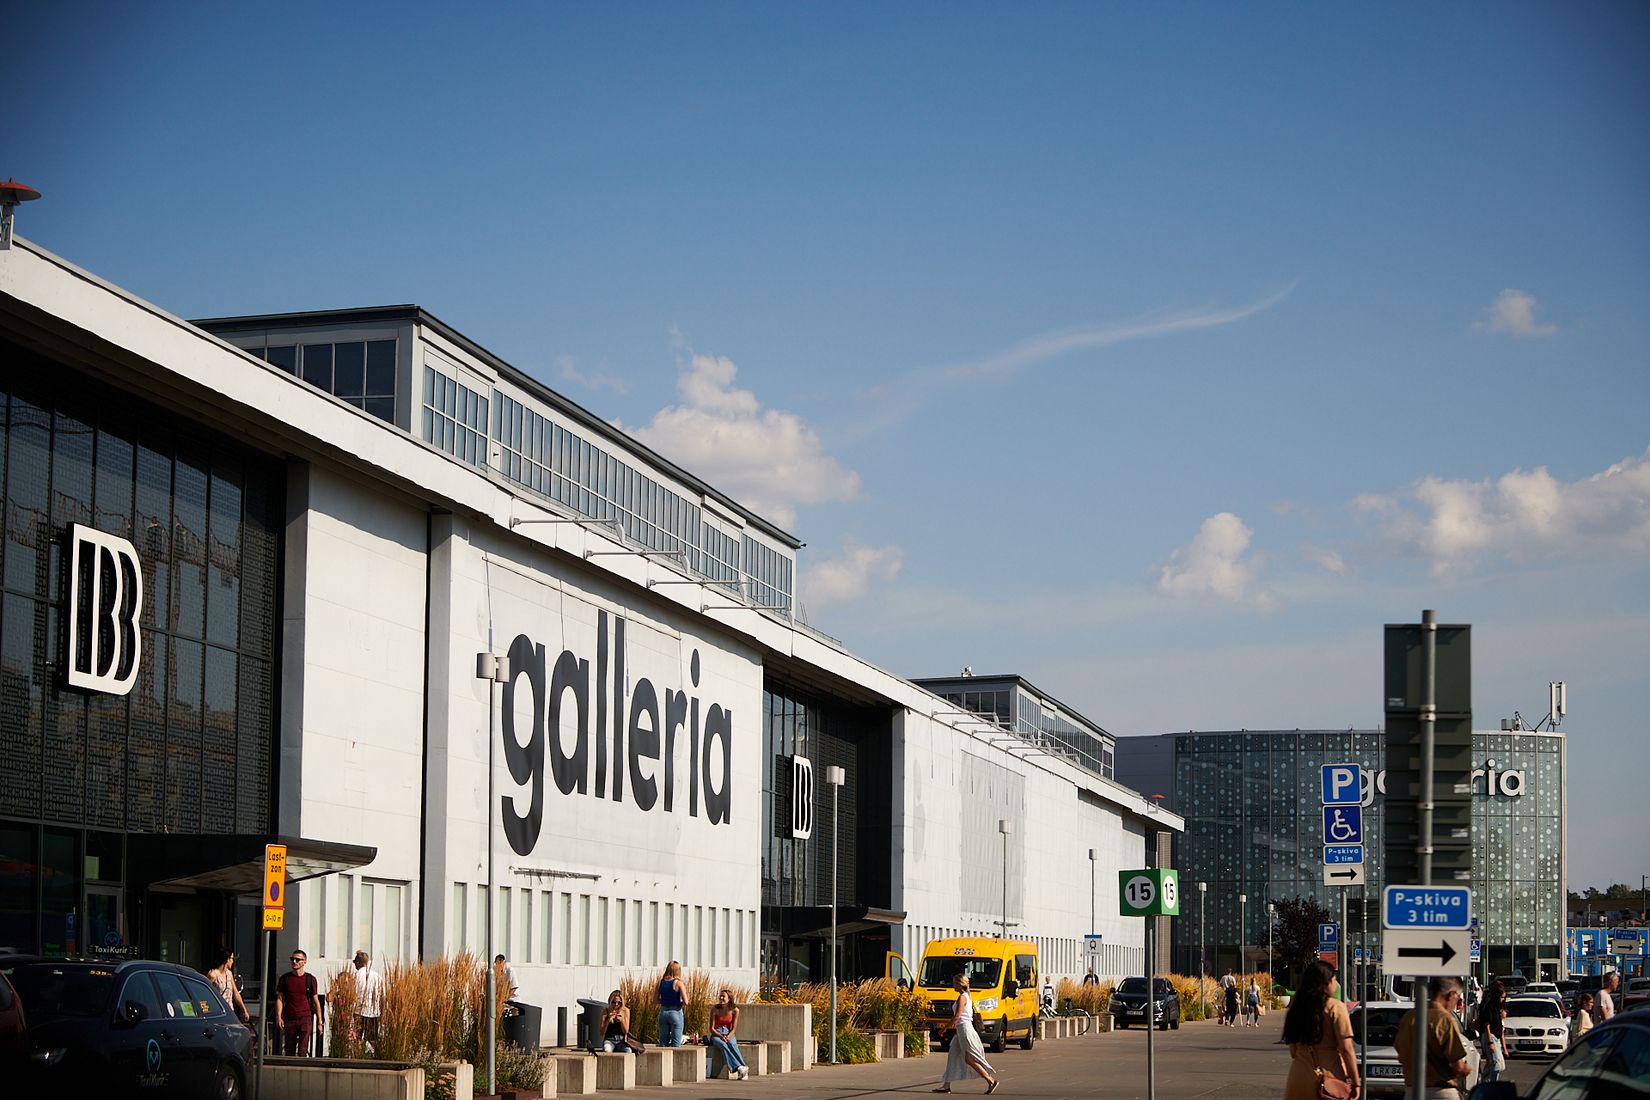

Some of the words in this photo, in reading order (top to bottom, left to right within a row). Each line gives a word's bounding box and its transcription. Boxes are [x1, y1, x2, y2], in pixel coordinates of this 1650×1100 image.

[501, 609, 732, 857] galleria
[1331, 768, 1354, 800] P
[1361, 758, 1526, 808] gria
[270, 865, 282, 873] zon
[1129, 882, 1151, 901] 15
[1164, 882, 1175, 901] 15
[1394, 892, 1462, 907] P-skiva
[1407, 910, 1418, 923] 3
[1424, 909, 1449, 923] tim
[1323, 926, 1334, 941] P
[1375, 1067, 1390, 1075] LRX
